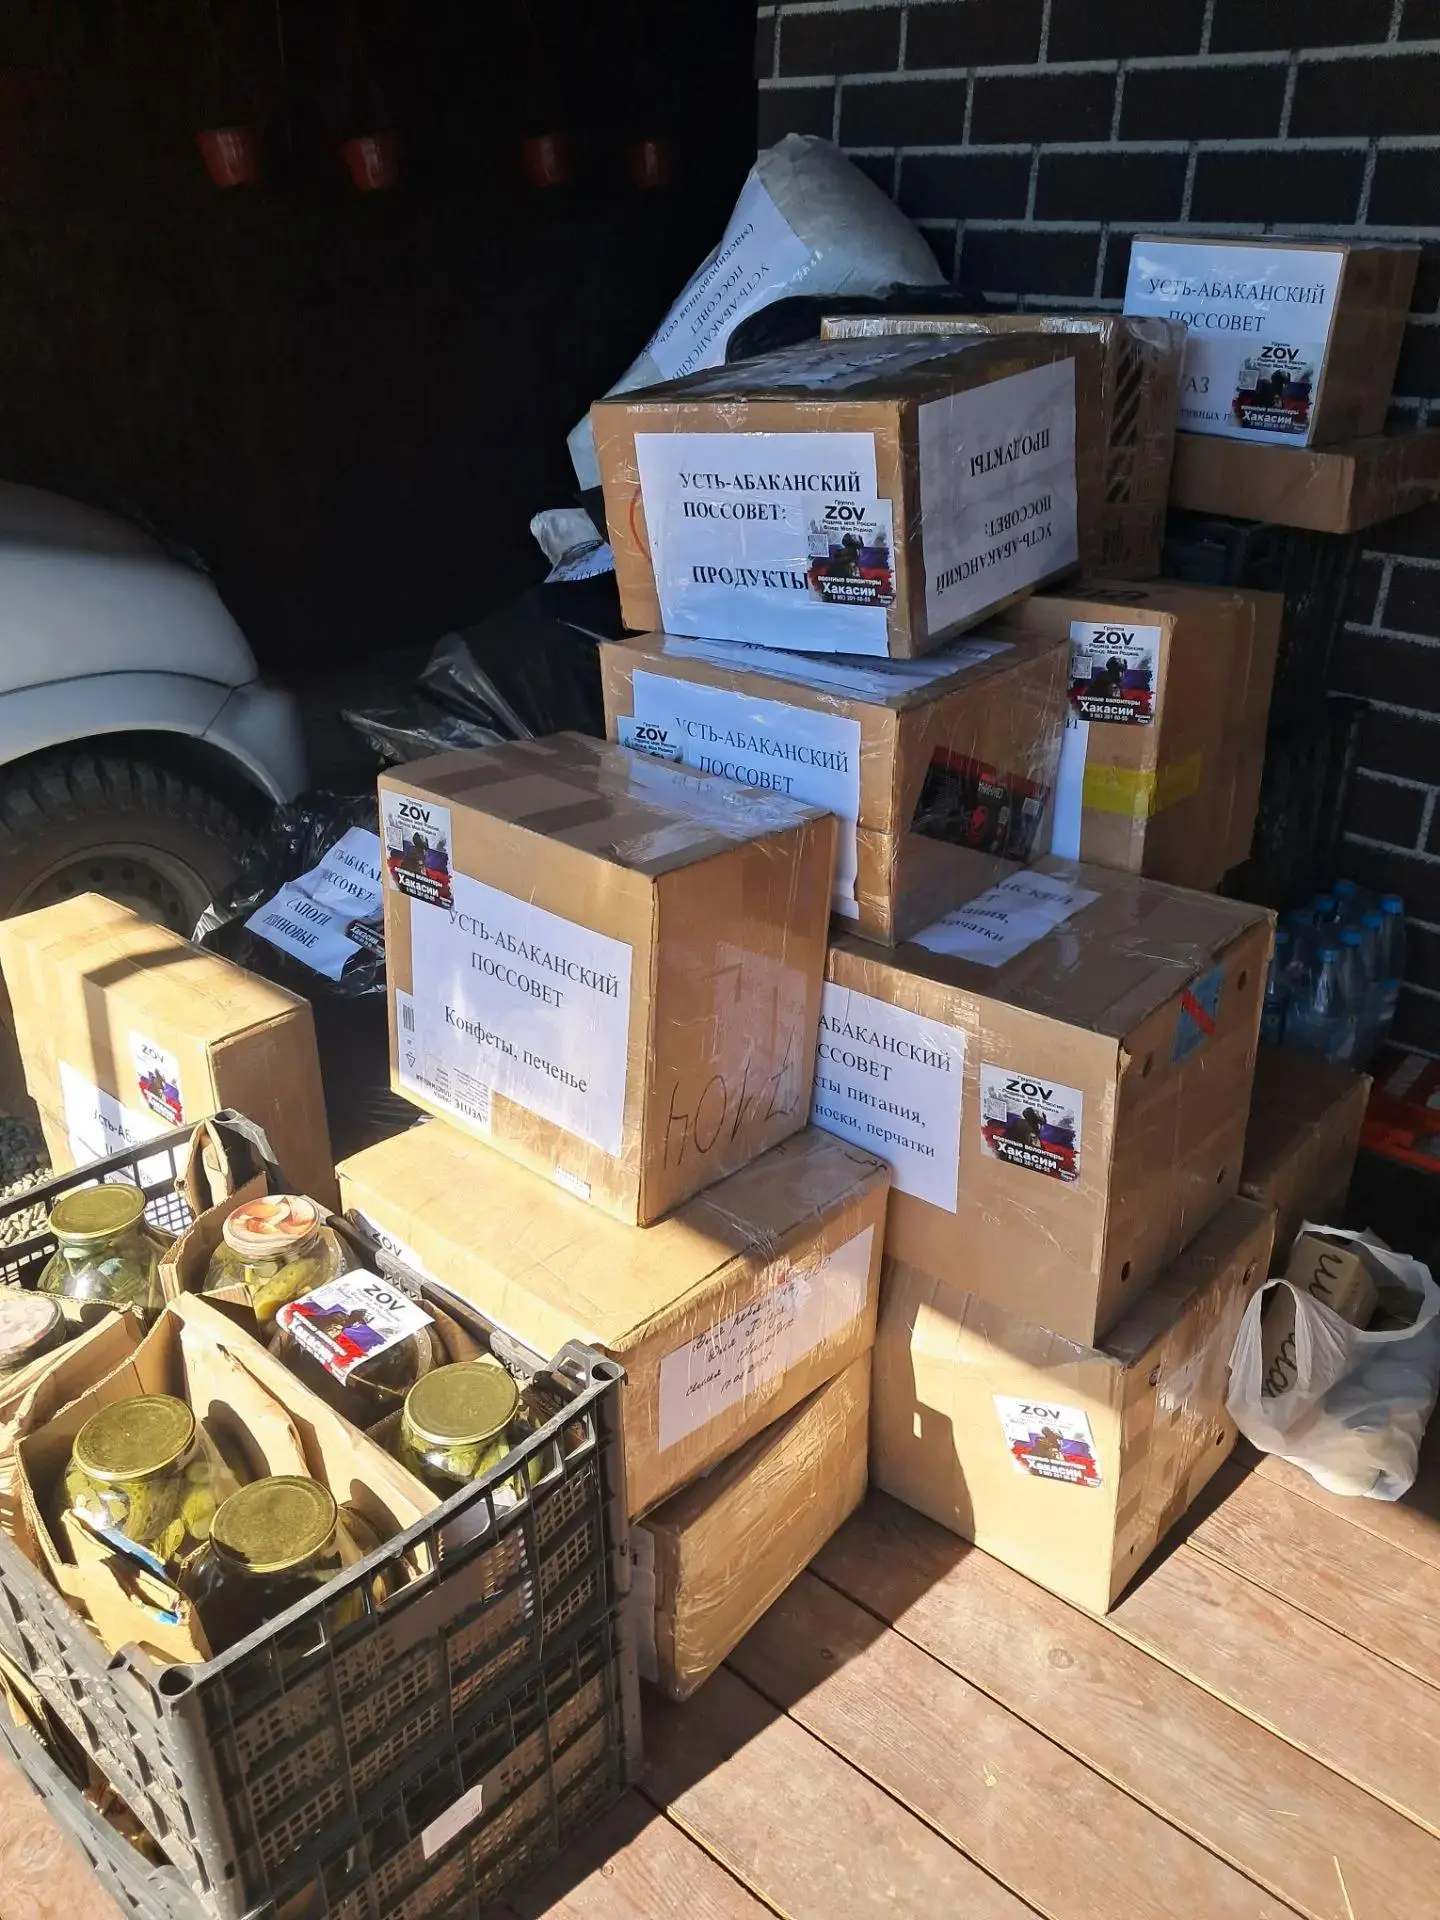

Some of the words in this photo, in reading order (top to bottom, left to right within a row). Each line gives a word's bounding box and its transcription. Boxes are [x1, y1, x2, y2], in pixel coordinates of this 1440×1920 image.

[690, 265, 744, 337] ПОССОВЕТ
[1149, 277, 1326, 305] УСТЬ-АБАКАНСКИЙ
[1168, 309, 1265, 332] ПОССОВЕТ
[1261, 346, 1299, 360] ZOV
[1182, 375, 1210, 394] АЗ
[1242, 410, 1292, 424] Хакасии
[970, 428, 1050, 477] ПРОДУКТЫ
[680, 471, 861, 492] УСТЬ-АБАКАНСКИЙ
[683, 501, 787, 520] ПОССОВЕТ:
[824, 506, 865, 521] ZOV
[984, 494, 1052, 538] ПОССОВЕТ:
[936, 523, 1053, 595] УСТЬ-АБАКАНСКИЙ
[692, 566, 808, 590] ПРОДУКТЫ
[823, 582, 876, 597] Хакасии
[1092, 631, 1135, 645] ZOV
[1080, 701, 1134, 716] Хакасии
[636, 726, 668, 742] ZOV
[673, 714, 849, 773] УСТЬ-АБАКАНСКИЙ
[699, 755, 794, 794] ПОССОВЕТ
[399, 802, 430, 823] ZOV
[398, 873, 439, 897] Хакасии
[286, 897, 333, 928] САПОГИ
[954, 906, 1010, 924] ания,
[449, 909, 619, 998] УСТЬ-АБАКАНСКИЙ
[471, 951, 564, 1009] ПОССОВЕТ
[141, 1043, 164, 1063] ZOV
[444, 1005, 518, 1061] Конфеты,
[523, 1049, 588, 1094] печенье
[1005, 1078, 1053, 1100] ZOV
[847, 1086, 927, 1128] питания,
[815, 1104, 862, 1132] носки,
[866, 1122, 935, 1157] перчатки
[997, 1141, 1057, 1169] Хакасии
[370, 1230, 402, 1257] ZOV
[363, 1284, 405, 1311] ZOV
[1018, 1404, 1060, 1420] ZOV
